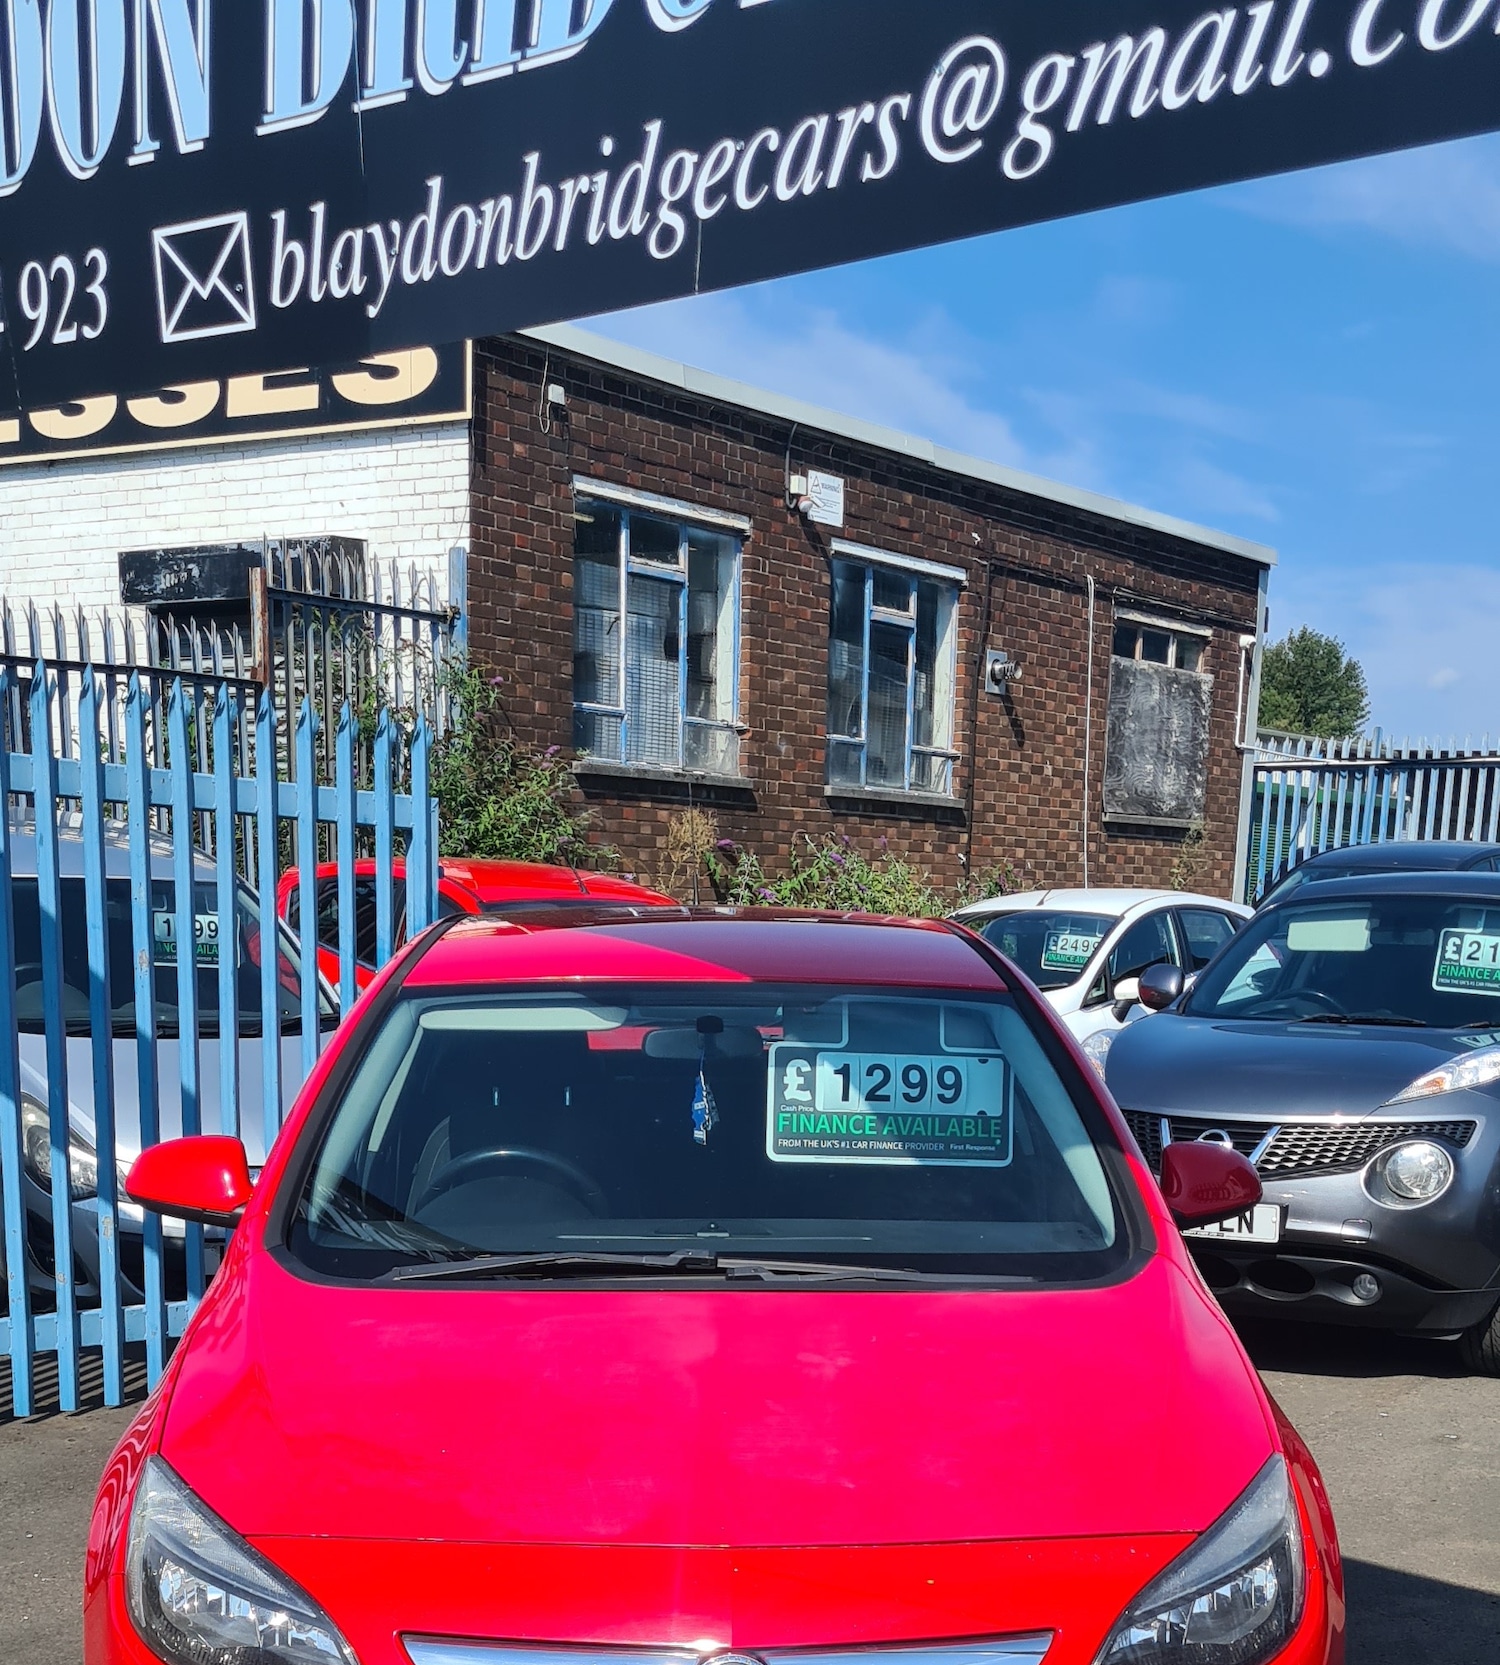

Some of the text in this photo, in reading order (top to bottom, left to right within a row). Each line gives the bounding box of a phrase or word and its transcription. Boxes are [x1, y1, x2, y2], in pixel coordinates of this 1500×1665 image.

[20, 0, 1500, 351] 923 blaydonbridgecars@gmail.co
[1439, 965, 1491, 980] FINANCE
[777, 1113, 1002, 1138] FINANCE AVAILABLE
[778, 1139, 801, 1148] FROM
[803, 1139, 819, 1148] THE
[820, 1140, 840, 1148] UK'S
[851, 1140, 868, 1149] CAR
[869, 1141, 904, 1150] FINANCE
[905, 1142, 945, 1151] PROVIDER
[965, 1144, 996, 1152] Response
